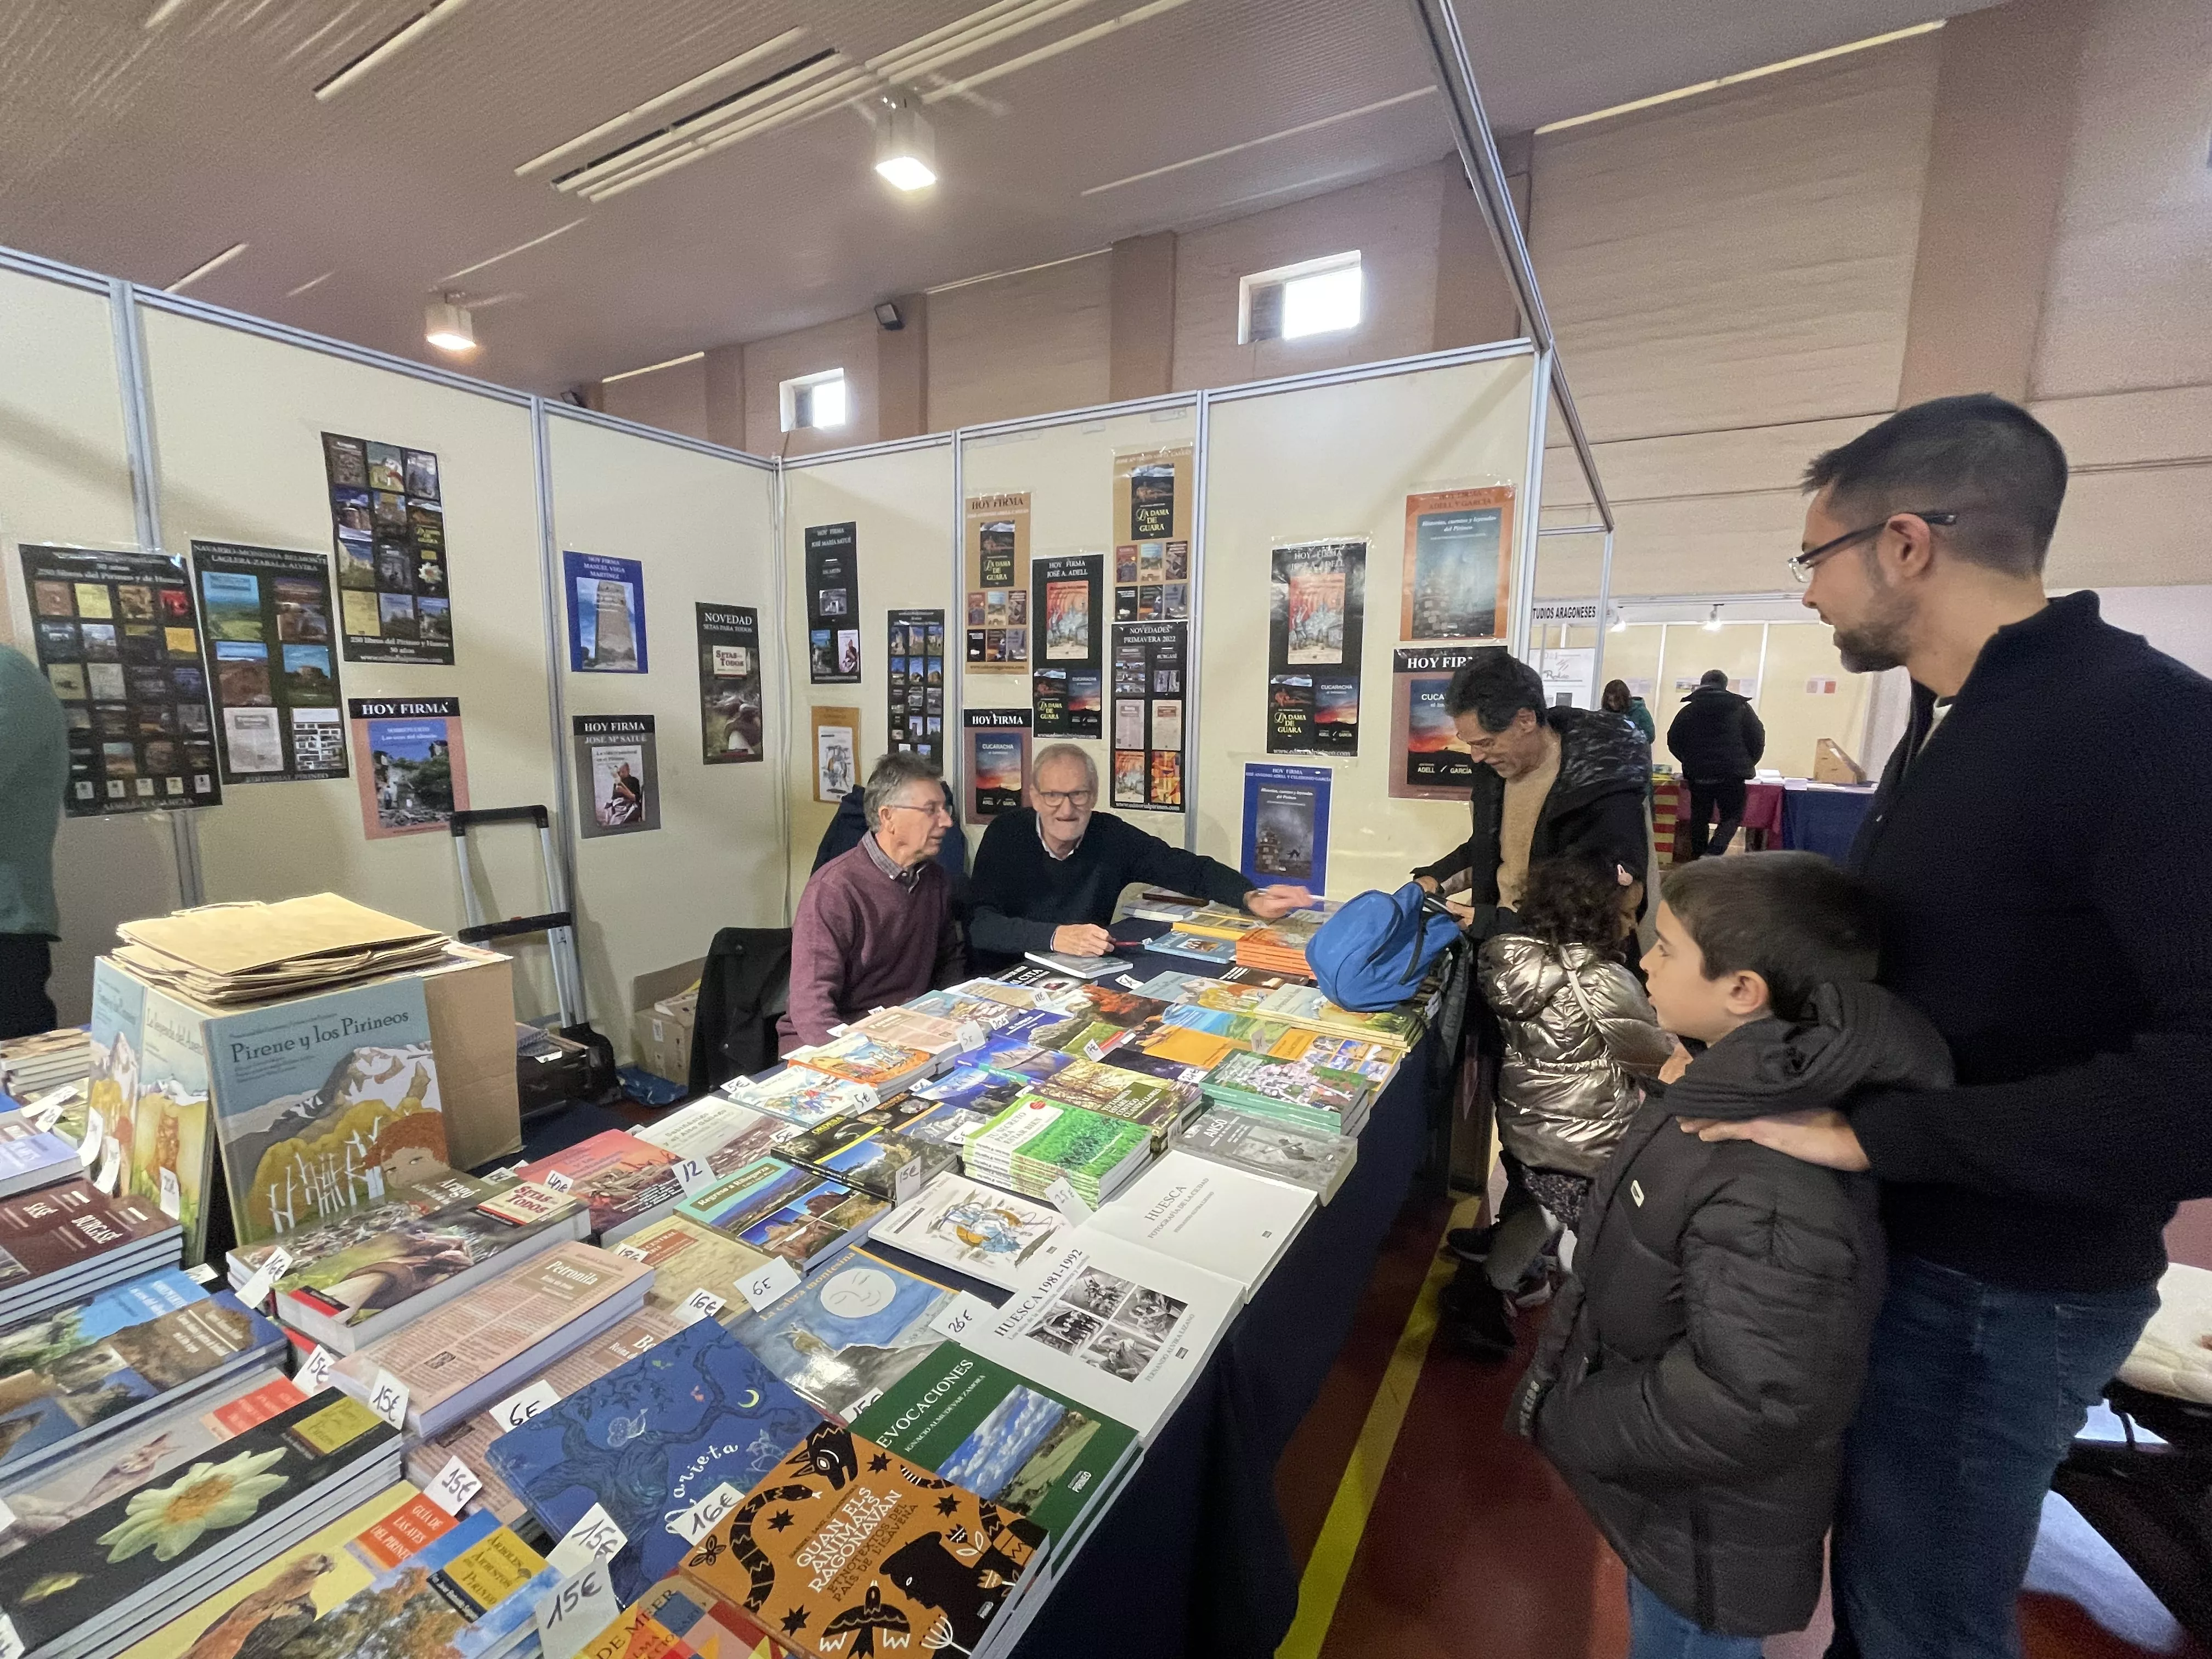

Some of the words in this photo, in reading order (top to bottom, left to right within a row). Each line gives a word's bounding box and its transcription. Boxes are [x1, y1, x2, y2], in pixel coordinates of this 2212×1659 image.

[972, 500, 990, 510] HOY
[994, 498, 1024, 507] FIRMA
[1139, 524, 1165, 532] GUARA
[1317, 550, 1342, 558] FIRMA
[1047, 570, 1060, 578] JOSÉ
[705, 613, 752, 625] NOVEDAD
[1555, 606, 1596, 619] ARAGONESES
[1130, 626, 1170, 634] NOVEDADES
[1407, 657, 1439, 669] HOY
[1442, 657, 1473, 668] FIR
[362, 704, 396, 715] HOY
[400, 703, 448, 714] FIRMA
[584, 723, 608, 732] HOY
[611, 722, 645, 731] FIRMA
[972, 716, 991, 724] HOY
[993, 716, 1023, 724] FIRMA
[231, 1040, 295, 1062] Pirene
[301, 1036, 310, 1049] y
[313, 1025, 340, 1043] los
[341, 1012, 408, 1036] Pirineos
[727, 1080, 750, 1092] 5€
[854, 1092, 870, 1108] 5€
[1116, 1098, 1139, 1116] CONTIGO
[1123, 1101, 1144, 1118] CUANDO
[1142, 1088, 1162, 1103] LLORES
[680, 1126, 697, 1138] Alto
[811, 1116, 844, 1135] ORDESA
[997, 1113, 1027, 1132] SECRETO
[1003, 1130, 1028, 1144] ESTAR
[1023, 1117, 1043, 1134] BIEN
[1203, 1119, 1228, 1138] ANSÓ
[776, 1131, 793, 1143] 5€
[953, 1132, 969, 1142] 5€
[994, 1130, 1016, 1141] PARA
[682, 1160, 702, 1182] 12
[900, 1165, 919, 1183] 15€
[697, 1188, 729, 1206] Regreso
[733, 1166, 769, 1187] Ribagorza
[1055, 1187, 1074, 1204] 25€
[506, 1194, 550, 1214] TODOS
[1144, 1186, 1187, 1221] HUESCA
[1148, 1207, 1181, 1238] FOTOGRAFÍA
[1177, 1200, 1187, 1210] DE
[1190, 1178, 1209, 1197] CIUDAD
[647, 1231, 676, 1250] CENTRAL
[545, 1261, 598, 1285] Petronila
[777, 1290, 805, 1311] cabra
[806, 1252, 856, 1289] montesina
[994, 1295, 1043, 1337] HUESCA
[1038, 1249, 1083, 1294] 1981-1992
[690, 1292, 716, 1317] 16€
[949, 1309, 973, 1333] 26€
[1144, 1353, 1169, 1381] FERNANDO
[1167, 1334, 1182, 1354] ALVIRA
[1178, 1314, 1195, 1334] LIZANO
[373, 1385, 399, 1422] 15€
[876, 1359, 974, 1448] EVOCACIONES
[905, 1424, 932, 1452] IGNACIO
[962, 1374, 986, 1399] ZAMORA
[442, 1468, 477, 1502] 15€
[413, 1505, 431, 1523] GUÍA
[427, 1517, 444, 1531] DE
[692, 1493, 737, 1535] 16€
[370, 1525, 388, 1543] DEL
[393, 1515, 411, 1531] LAS
[404, 1527, 427, 1544] AVES
[797, 1519, 845, 1567] QUAN
[842, 1487, 871, 1517] ELS
[812, 1496, 880, 1573] ANIMALS
[808, 1489, 902, 1593] RAGONAVAN
[827, 1523, 890, 1593] ETNOTEXTOS
[888, 1504, 907, 1521] DEL
[858, 1558, 873, 1572] DE
[546, 1571, 602, 1629] 15€
[597, 1635, 625, 1659] DE
